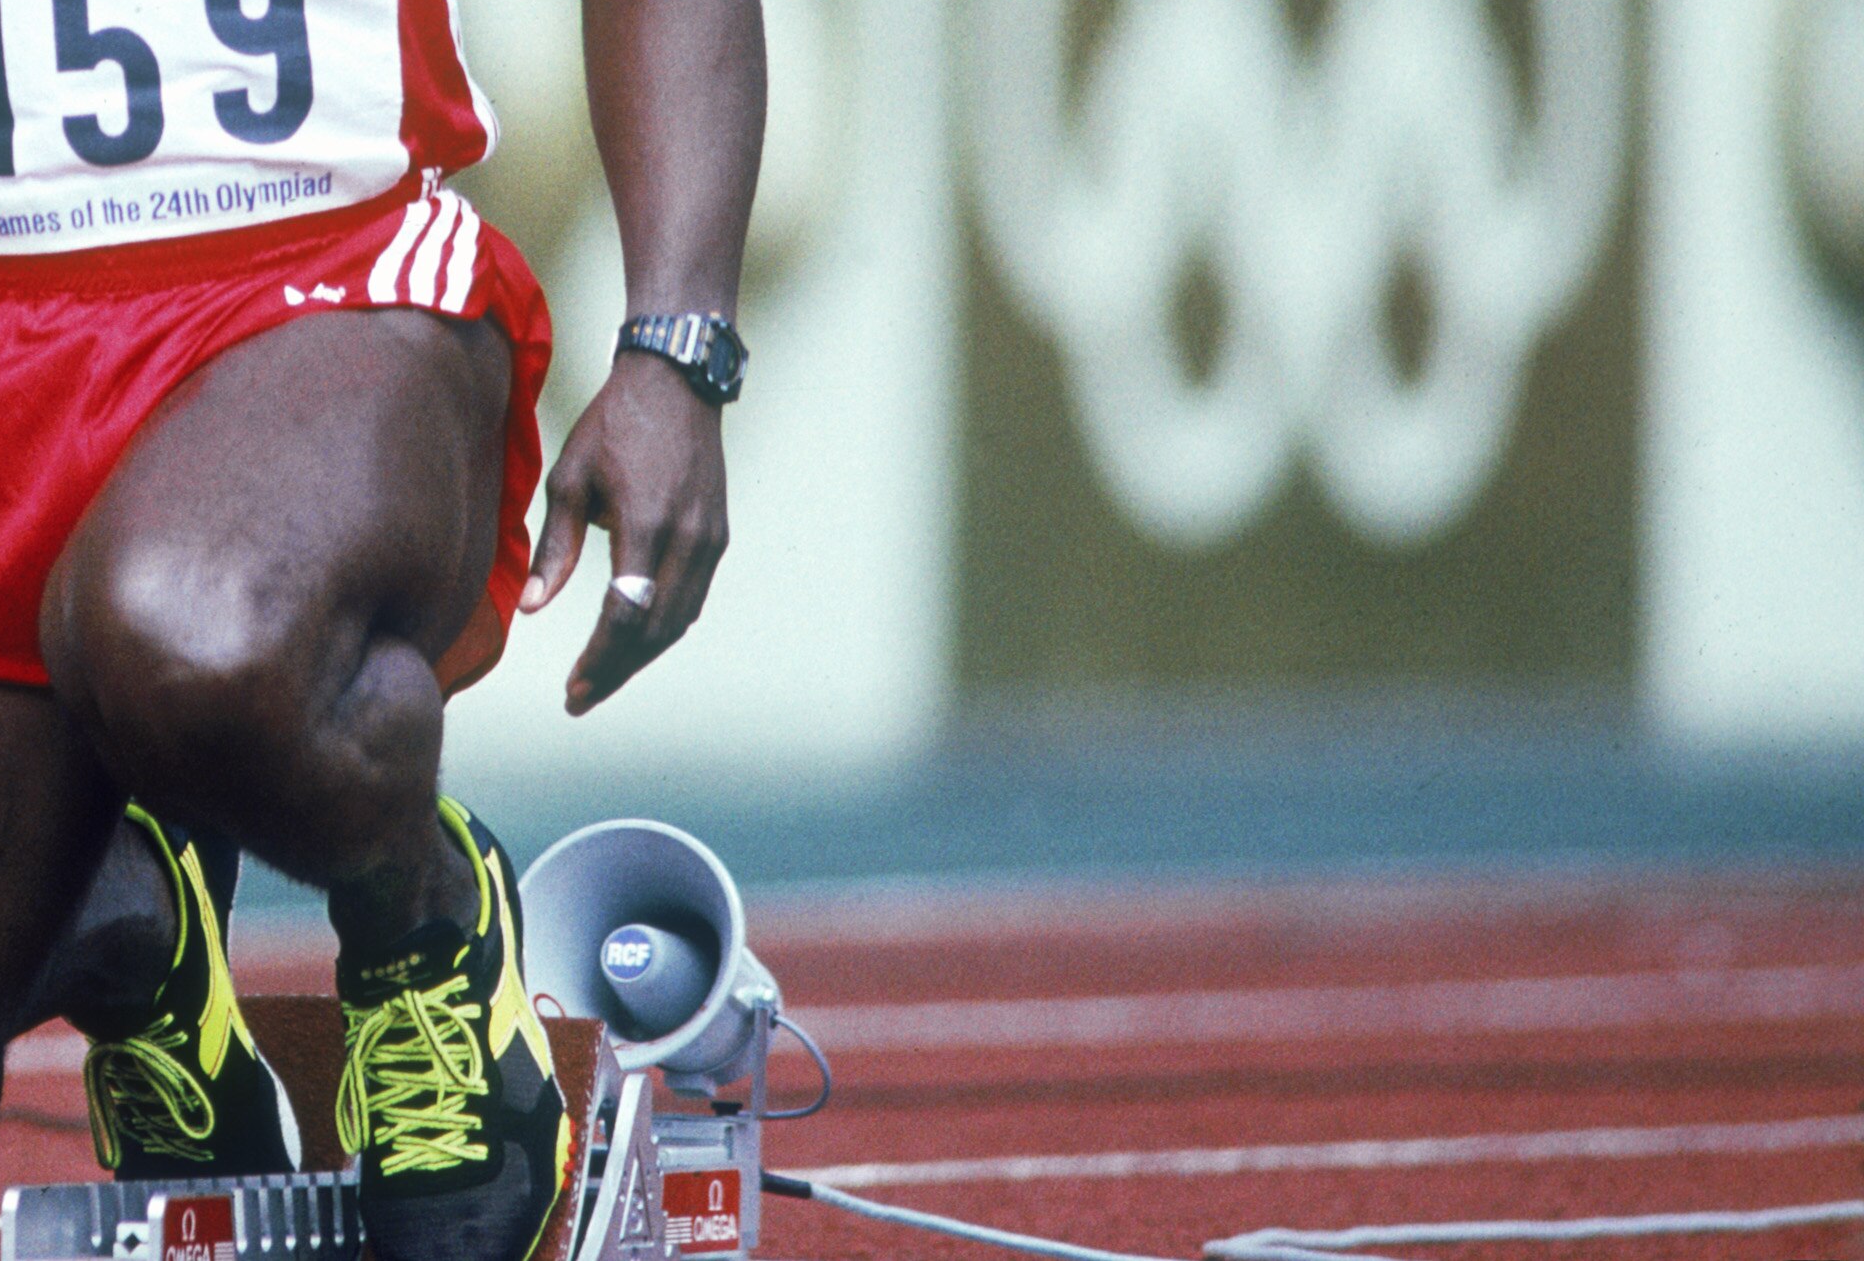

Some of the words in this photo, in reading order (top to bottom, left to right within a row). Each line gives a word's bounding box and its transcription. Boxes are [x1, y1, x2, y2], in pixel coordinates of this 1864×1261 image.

[71, 197, 95, 227] of
[102, 193, 141, 225] the
[151, 188, 210, 222] 24th
[217, 170, 333, 213] Olympiad
[607, 942, 650, 967] RCF
[693, 1214, 737, 1241] OMEGA
